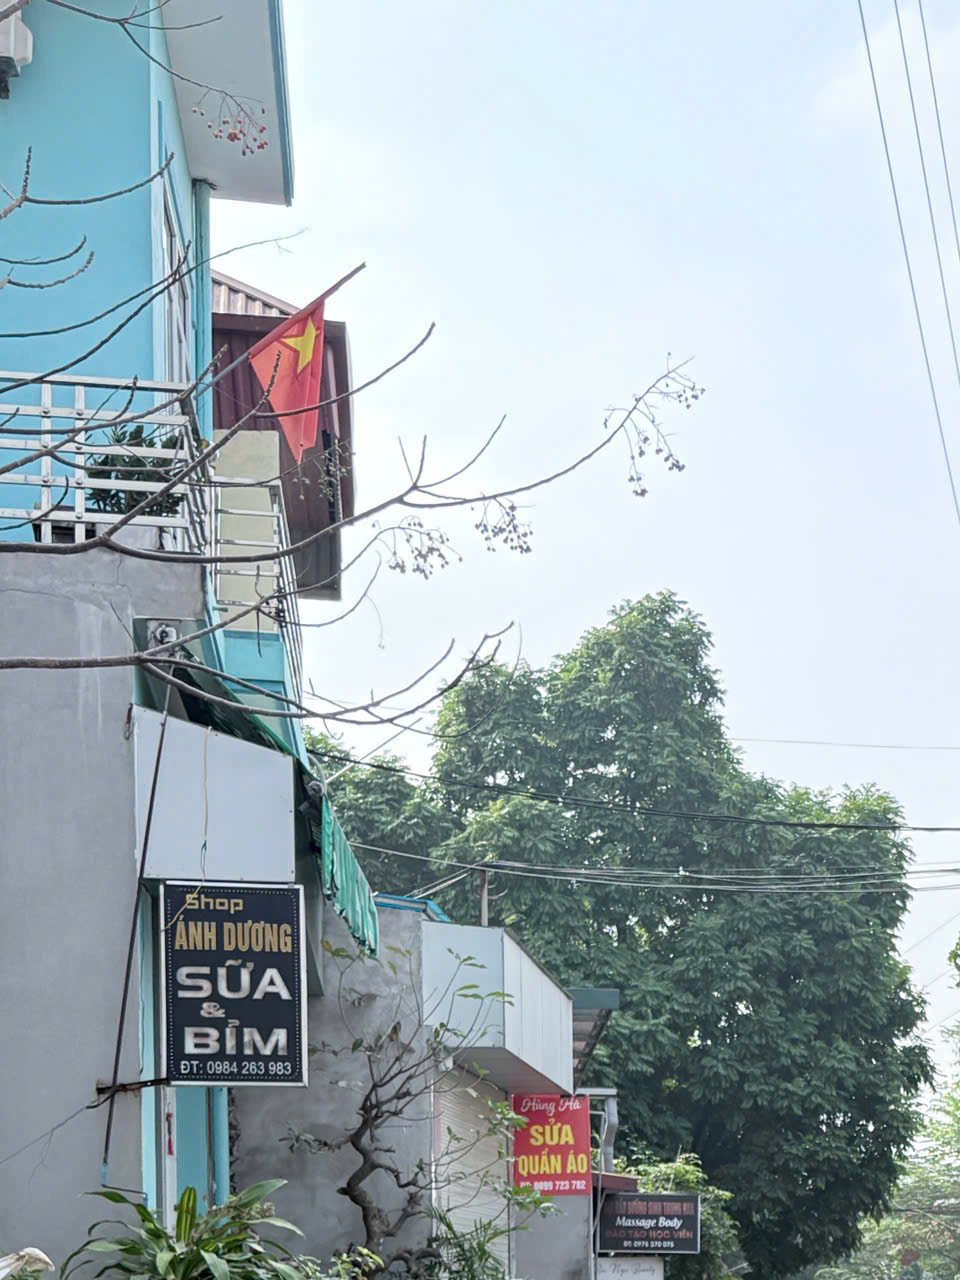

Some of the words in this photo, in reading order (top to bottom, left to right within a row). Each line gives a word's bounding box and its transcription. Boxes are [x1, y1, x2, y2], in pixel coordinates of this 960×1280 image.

[185, 893, 244, 914] Shop
[174, 915, 217, 951] ÁNH
[223, 919, 293, 953] DƯƠNG
[176, 959, 293, 1000] SỮA
[200, 1001, 226, 1018] &
[184, 1019, 288, 1056] BỈM
[180, 1060, 203, 1074] ĐT:
[207, 1060, 238, 1074] 0984
[241, 1060, 265, 1074] 263
[268, 1061, 292, 1075] 983
[529, 1117, 575, 1146] SỬA
[518, 1148, 562, 1177] QUẦN
[566, 1150, 588, 1174] ÁO
[616, 1216, 657, 1229] Massage
[658, 1216, 683, 1229] Body
